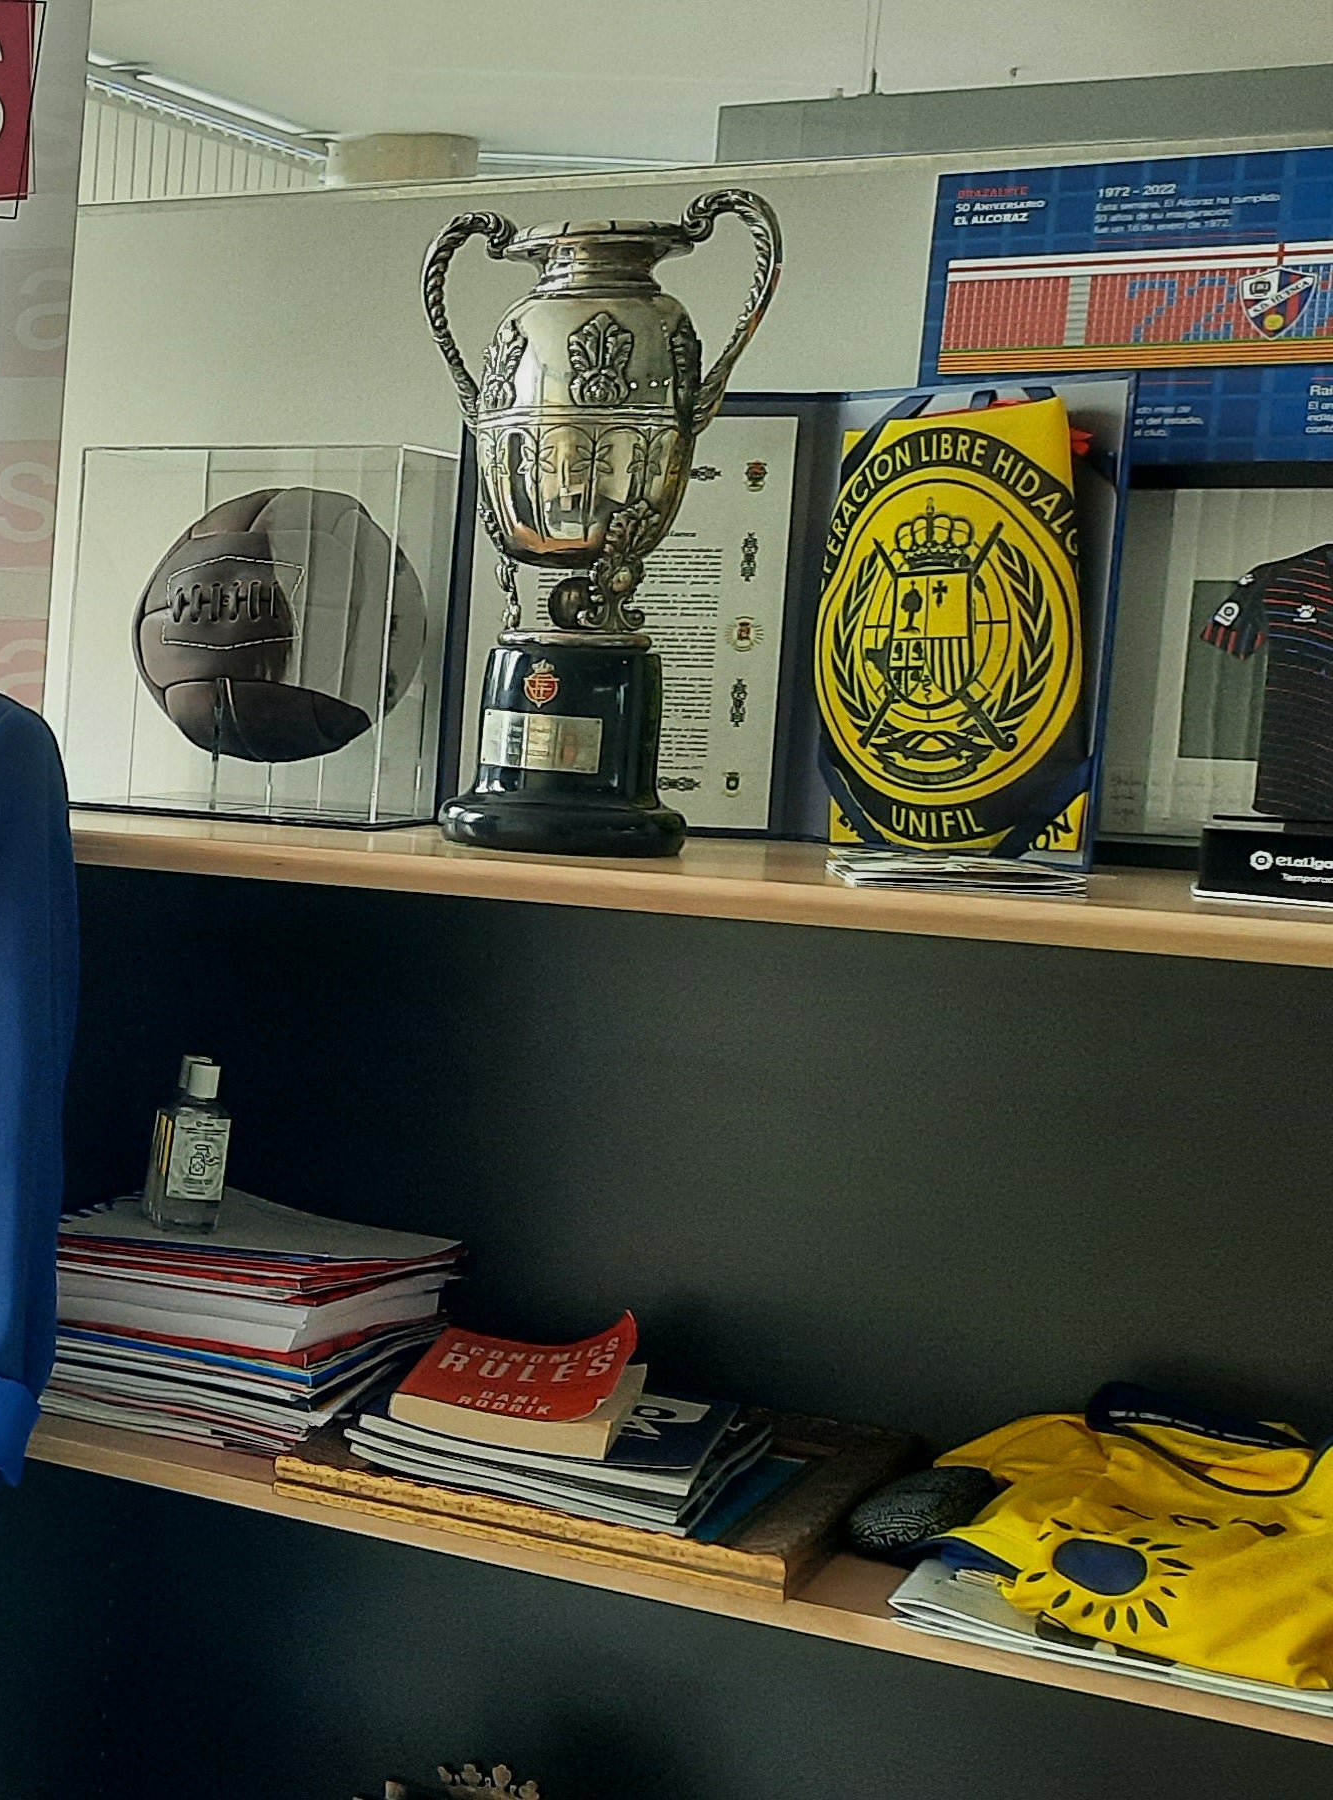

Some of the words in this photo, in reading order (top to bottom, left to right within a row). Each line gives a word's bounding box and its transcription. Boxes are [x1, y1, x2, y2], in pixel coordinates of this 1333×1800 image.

[1098, 186, 1131, 198] 1972
[1142, 184, 1177, 196] 2022
[953, 216, 968, 226] EL
[971, 213, 1029, 225] ALCORAZ
[822, 441, 912, 575] ERACION
[920, 433, 988, 466] LIBRE
[992, 448, 1078, 556] HIDALG
[891, 805, 985, 838] UNIFIL
[450, 1336, 620, 1364] ECONOMICS
[438, 1353, 615, 1383] RULES
[457, 1395, 552, 1416] RODRIK
[480, 1390, 541, 1404] DANI
